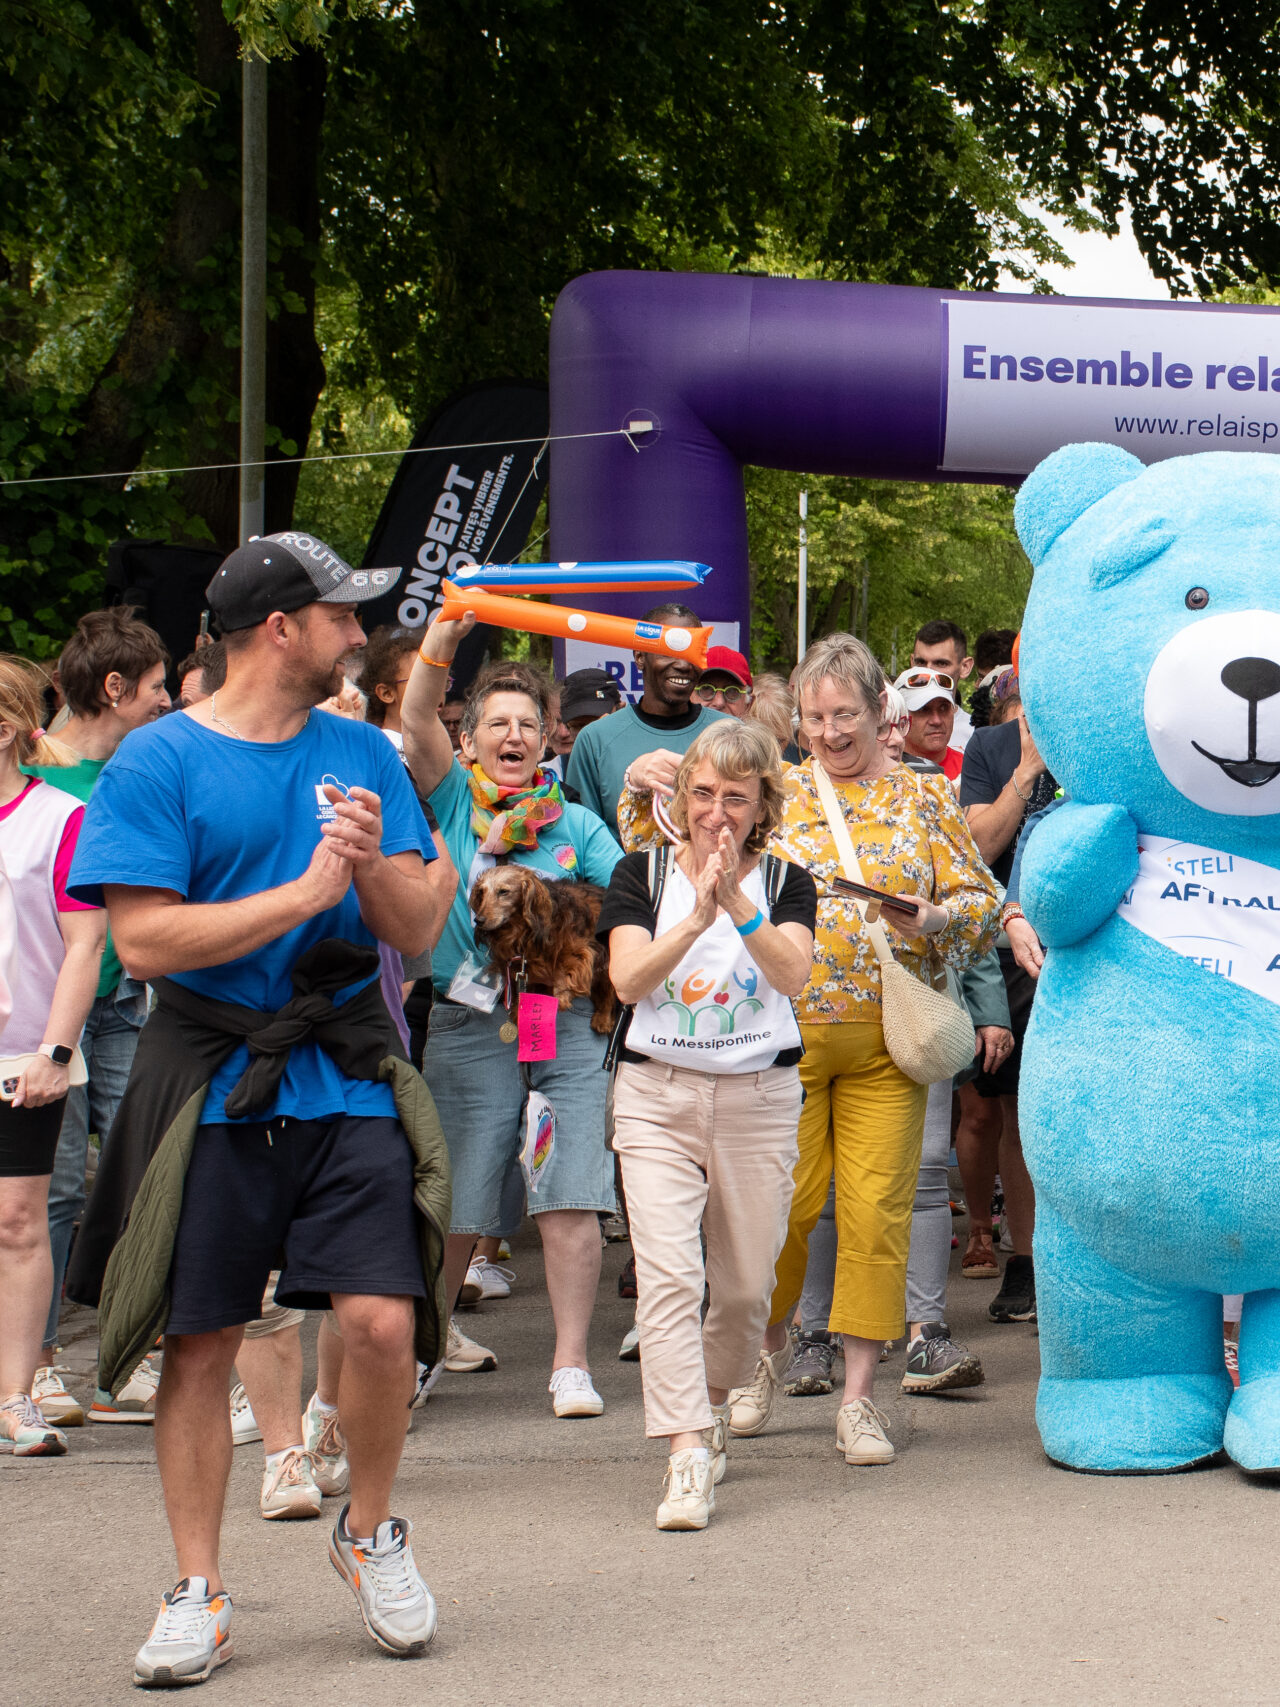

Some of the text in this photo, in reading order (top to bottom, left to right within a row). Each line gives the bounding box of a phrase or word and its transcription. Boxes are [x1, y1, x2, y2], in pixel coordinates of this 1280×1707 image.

[963, 344, 1193, 389] Ensemble
[457, 469, 495, 550] FAITES VIBRER
[277, 532, 350, 583] ROUTE
[396, 463, 475, 630] ONCEPT
[470, 528, 487, 553] VOS
[351, 570, 389, 587] 66
[1168, 855, 1234, 876] STELI
[530, 1003, 543, 1052] MARLEY
[650, 1029, 772, 1050] La Messipontine
